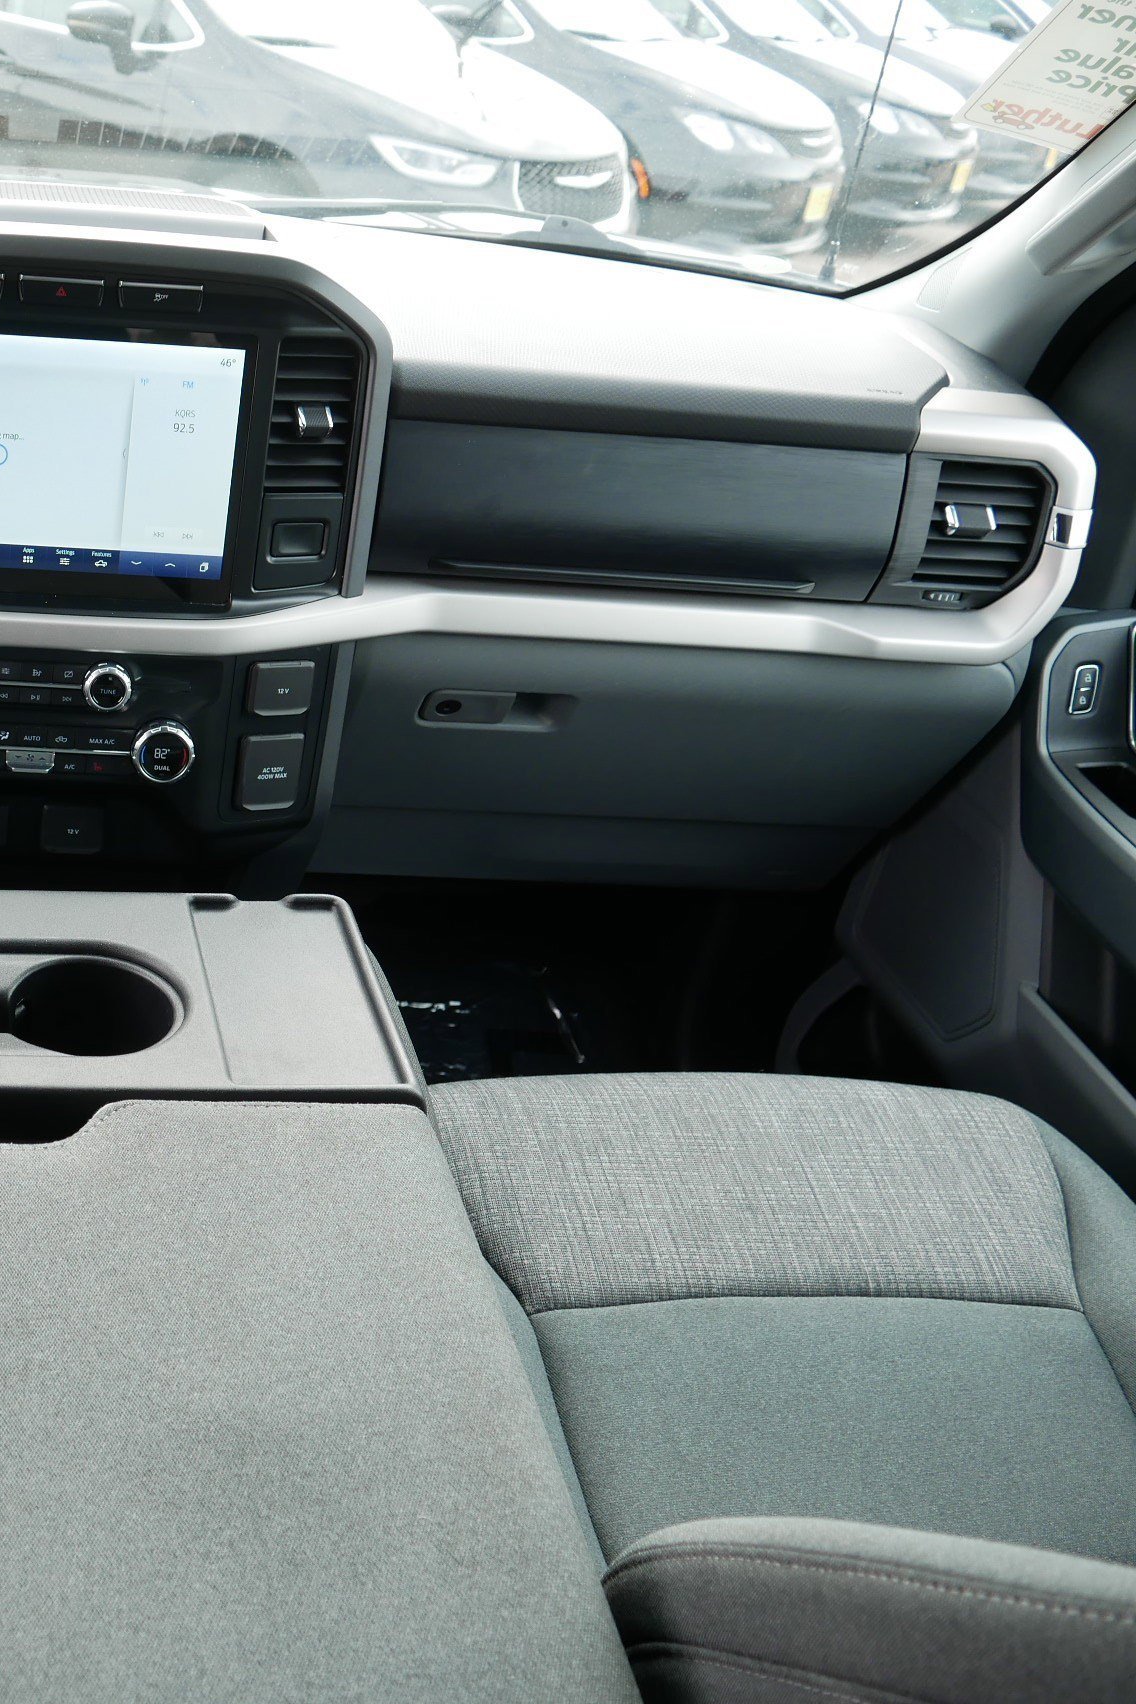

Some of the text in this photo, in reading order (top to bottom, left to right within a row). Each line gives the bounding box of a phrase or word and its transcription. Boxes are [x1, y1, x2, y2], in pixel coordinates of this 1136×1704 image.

[182, 381, 194, 389] FM
[175, 409, 196, 418] KQRS
[173, 422, 195, 434] 92.5
[55, 549, 75, 557] Settings
